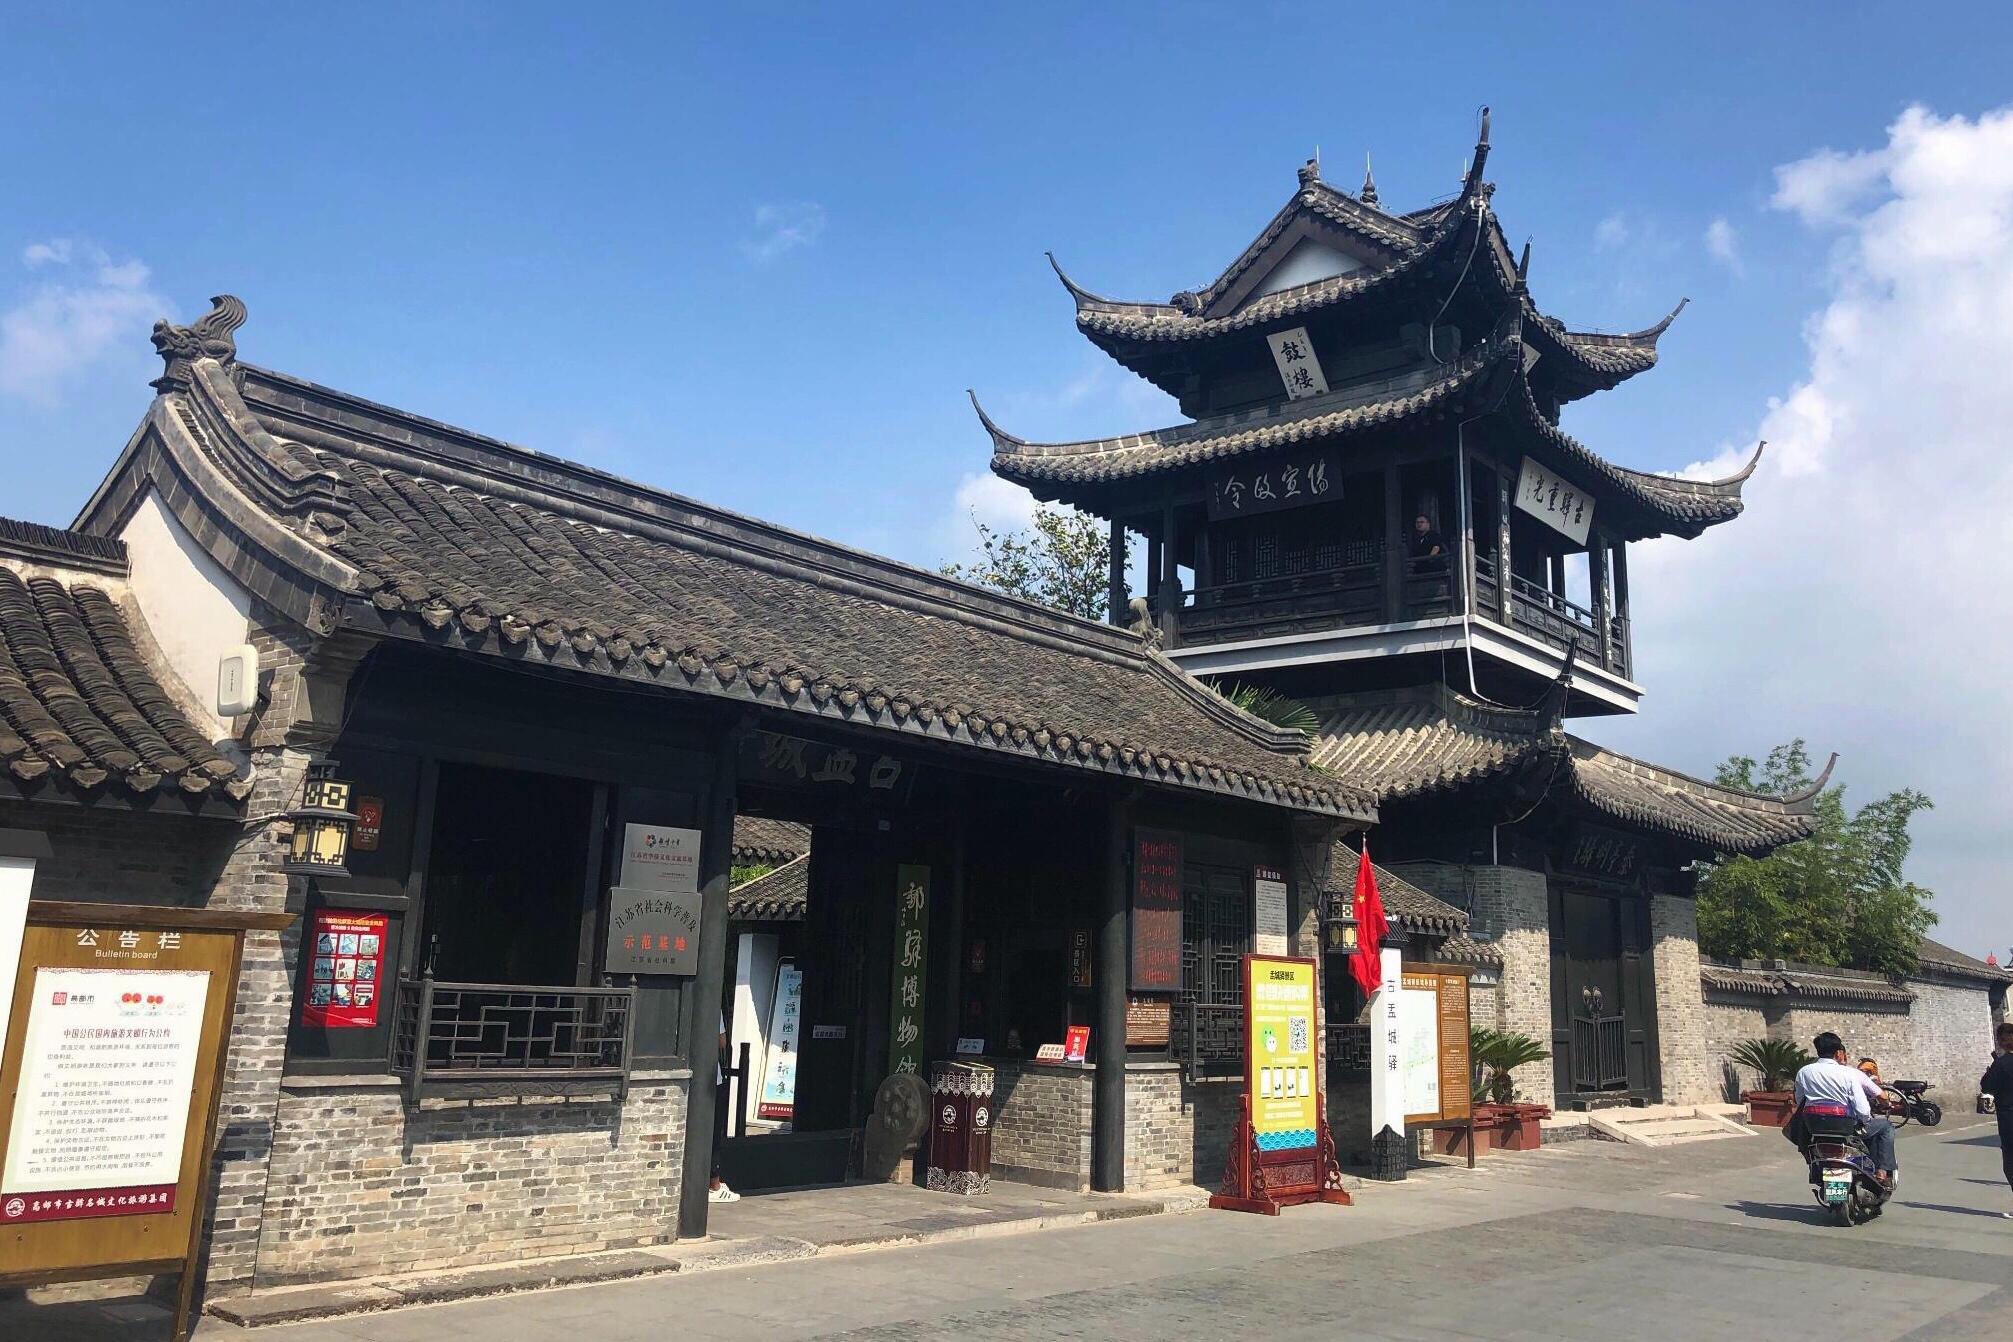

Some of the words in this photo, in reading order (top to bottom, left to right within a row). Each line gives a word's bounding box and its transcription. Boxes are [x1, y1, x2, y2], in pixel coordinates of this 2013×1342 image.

[77, 928, 181, 950] 公告栏
[623, 933, 688, 951] 示范基地
[95, 950, 130, 959] Bulletin
[132, 951, 158, 959] board
[1387, 979, 1398, 1071] 古盂城驿
